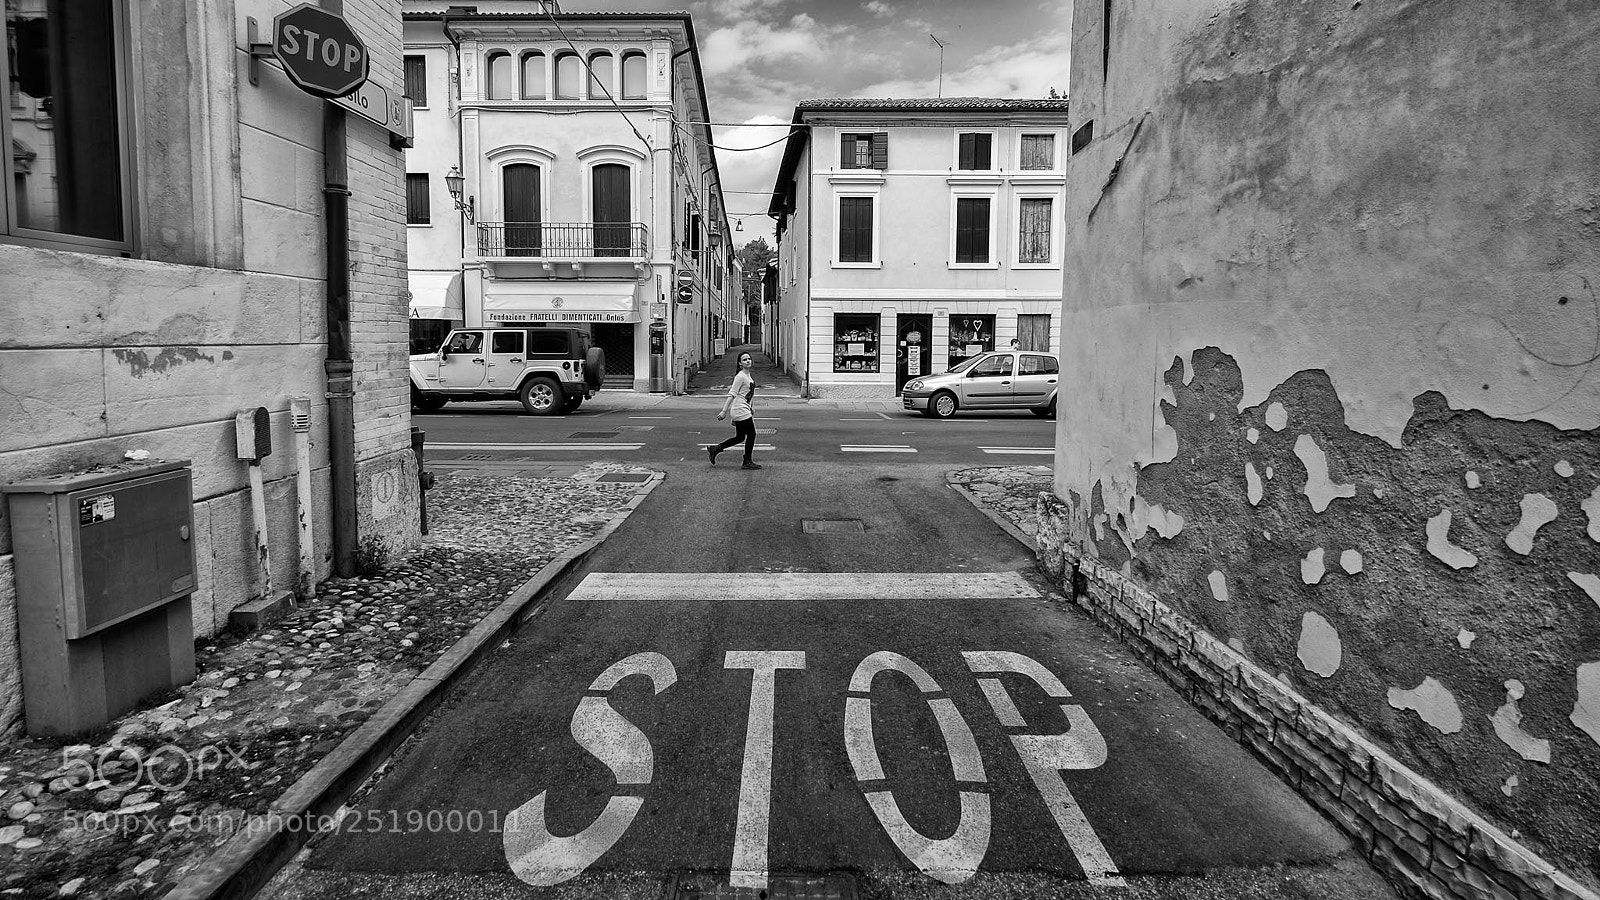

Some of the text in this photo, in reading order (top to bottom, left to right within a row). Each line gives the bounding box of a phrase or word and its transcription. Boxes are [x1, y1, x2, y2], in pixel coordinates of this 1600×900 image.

[281, 24, 361, 72] STOP
[344, 90, 368, 108] silo
[562, 313, 602, 321] DIMENTICATI
[503, 650, 1126, 888] STOP
